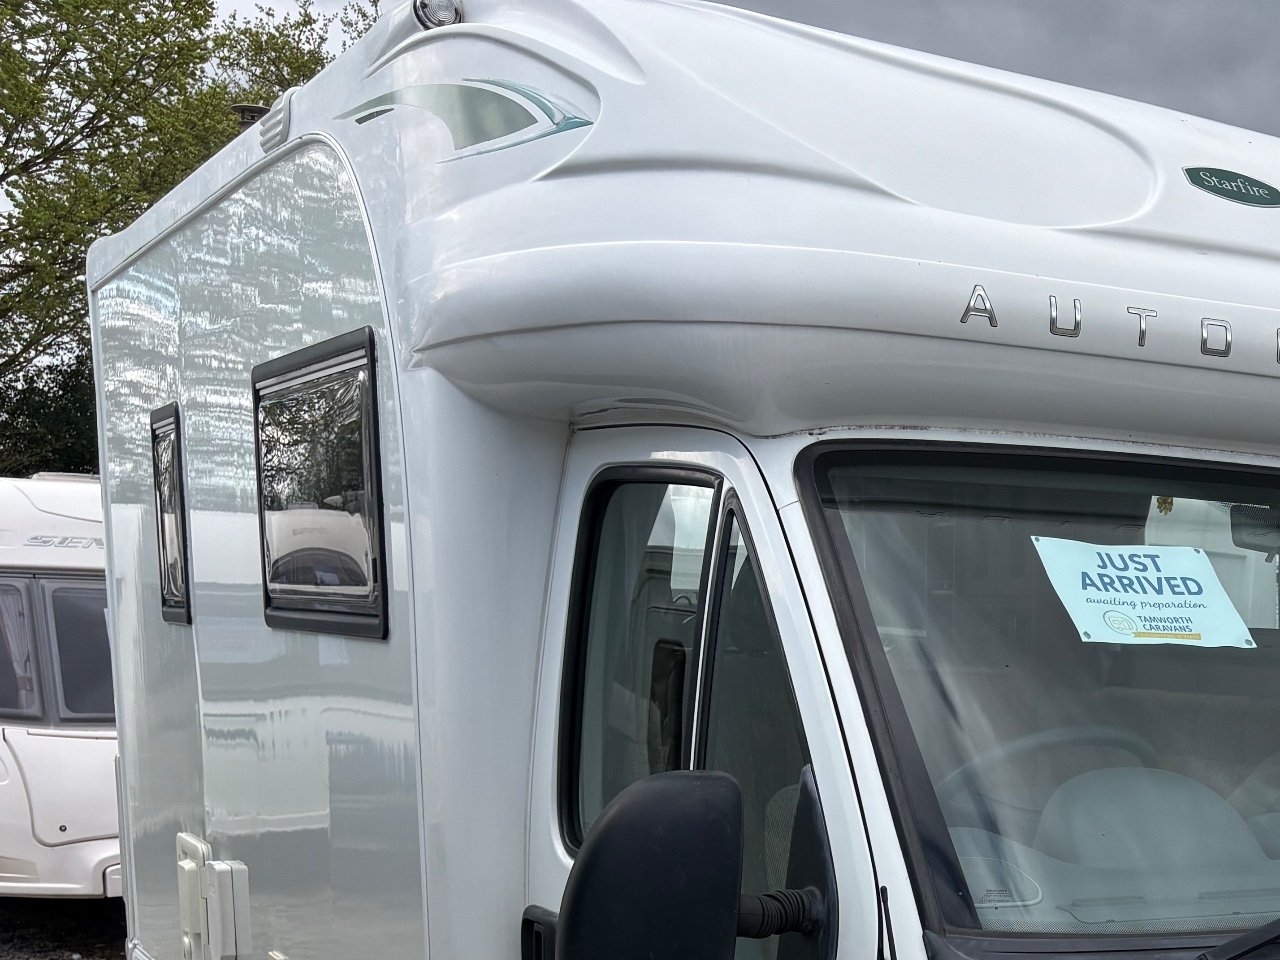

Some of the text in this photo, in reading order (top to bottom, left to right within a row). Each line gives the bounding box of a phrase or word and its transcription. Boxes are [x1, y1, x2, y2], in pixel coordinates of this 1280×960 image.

[1199, 171, 1271, 199] Starfire
[1096, 551, 1161, 572] JUST
[1081, 571, 1204, 596] ARRIVED
[1086, 597, 1207, 611] awaiting preparation
[1137, 615, 1193, 624] TAMWORTH
[1142, 624, 1193, 632] CARAVANS
